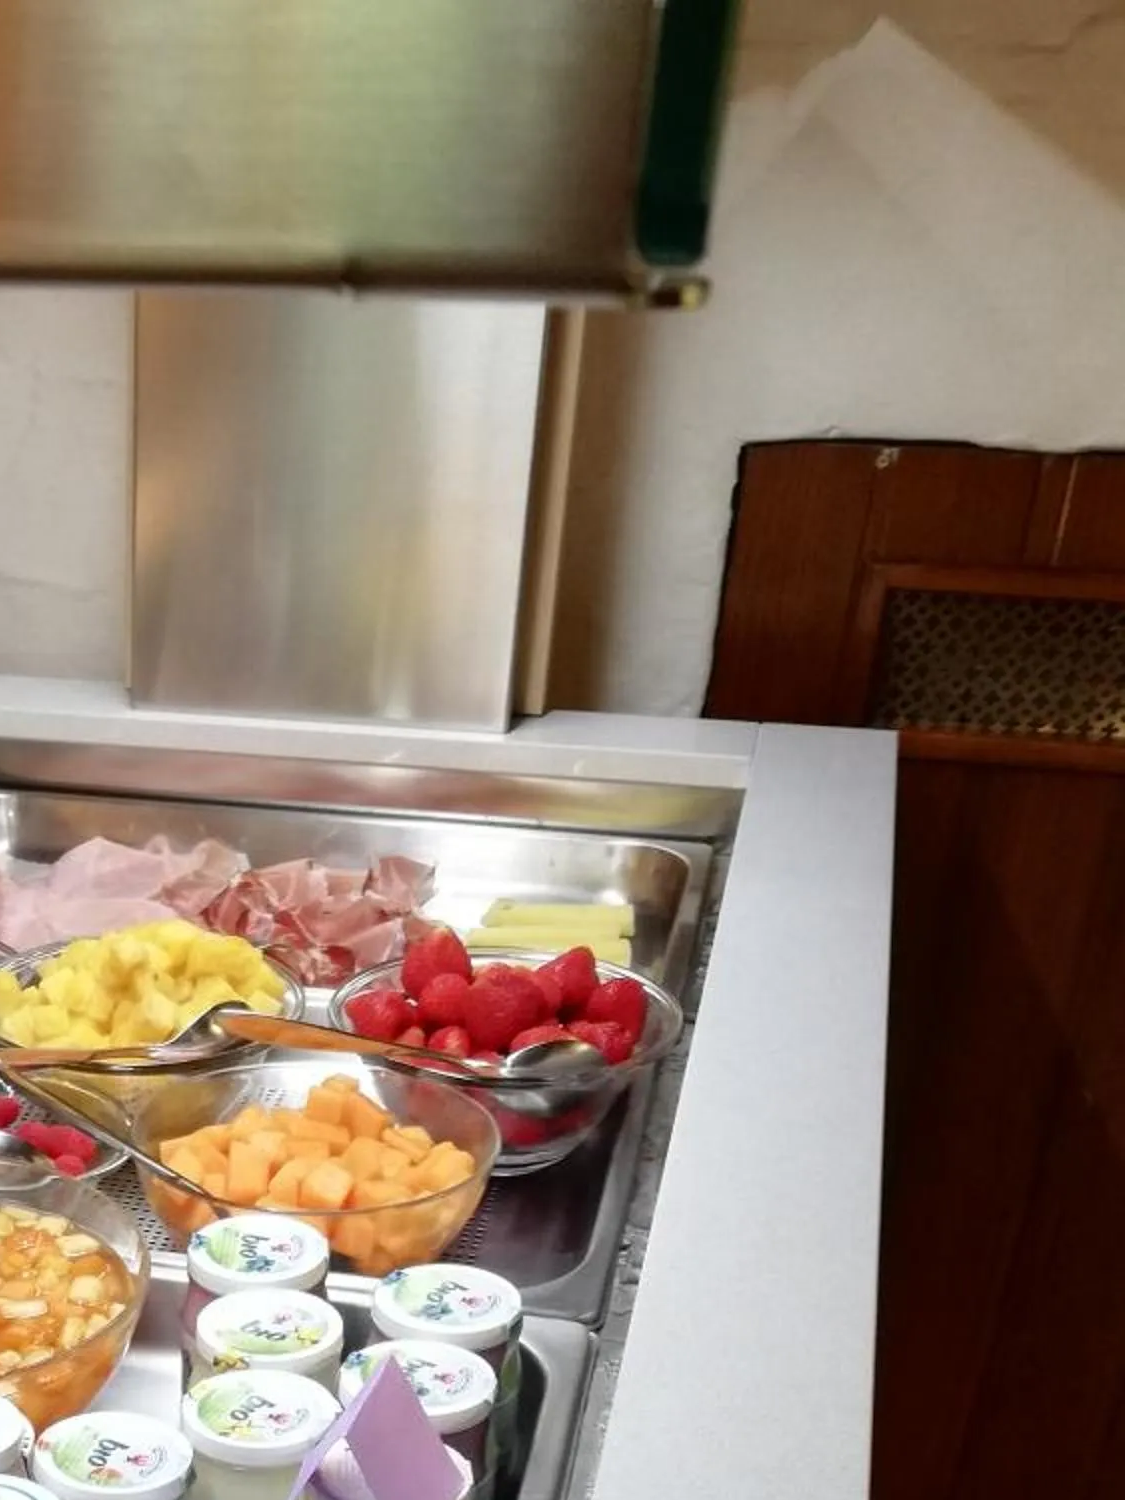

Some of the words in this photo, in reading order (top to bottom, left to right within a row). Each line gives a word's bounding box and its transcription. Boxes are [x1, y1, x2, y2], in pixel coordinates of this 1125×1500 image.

[239, 1233, 270, 1260] bio
[230, 1393, 276, 1422] bio
[87, 1436, 130, 1468] bio
